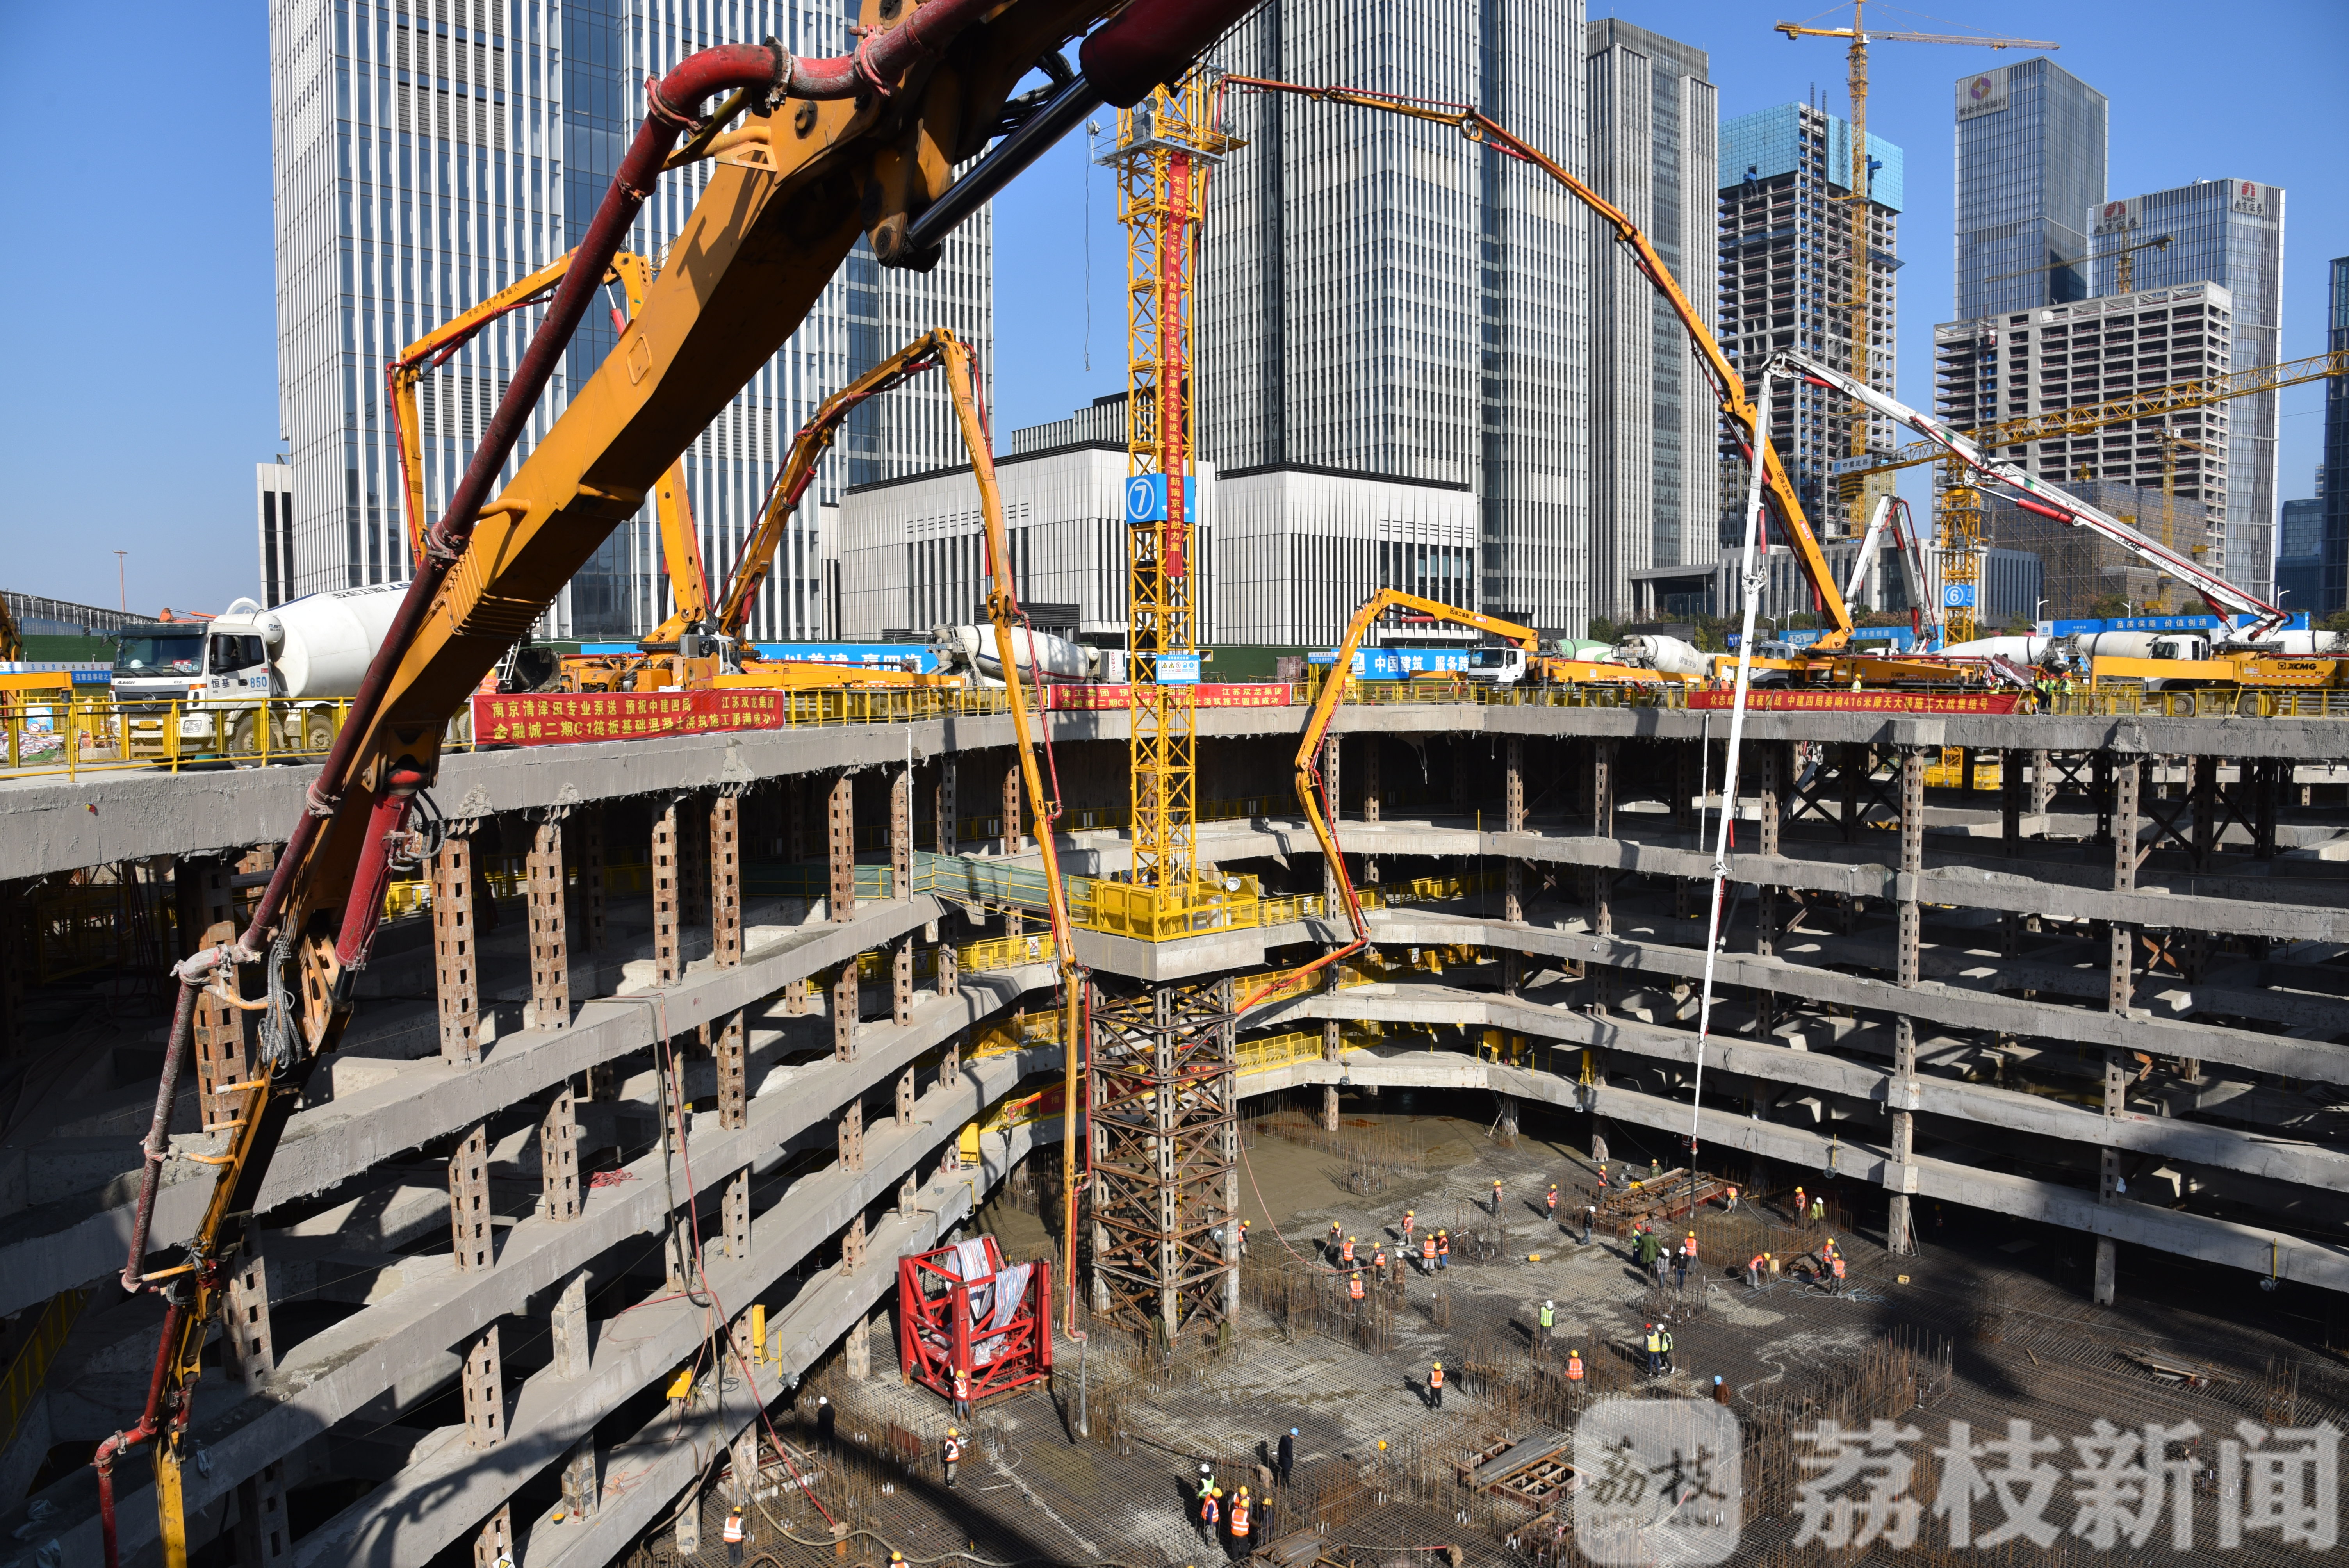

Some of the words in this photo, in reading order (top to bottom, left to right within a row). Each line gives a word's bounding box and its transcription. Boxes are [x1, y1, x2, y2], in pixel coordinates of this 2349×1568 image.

[1173, 175, 1184, 218] 不忘初心
[2235, 200, 2263, 214] 南京证券
[2105, 215, 2125, 223] NSC
[2094, 217, 2138, 235] 南京证券
[1135, 485, 1147, 513] 7
[2121, 537, 2144, 552] XCMG
[1950, 589, 1959, 602] 6
[2116, 620, 2156, 629] 品质保障
[2164, 618, 2207, 627] 价值创造
[1375, 655, 1424, 673] 中国建筑
[211, 678, 230, 688] 恒基
[250, 676, 267, 688] 850
[1062, 688, 1109, 697] 徐工集团
[1222, 687, 1282, 696] 江苏双龙集团
[626, 698, 692, 715] 预祝中建四局
[722, 695, 774, 709] 江苏双龙集团
[1710, 694, 1734, 706] 众志成
